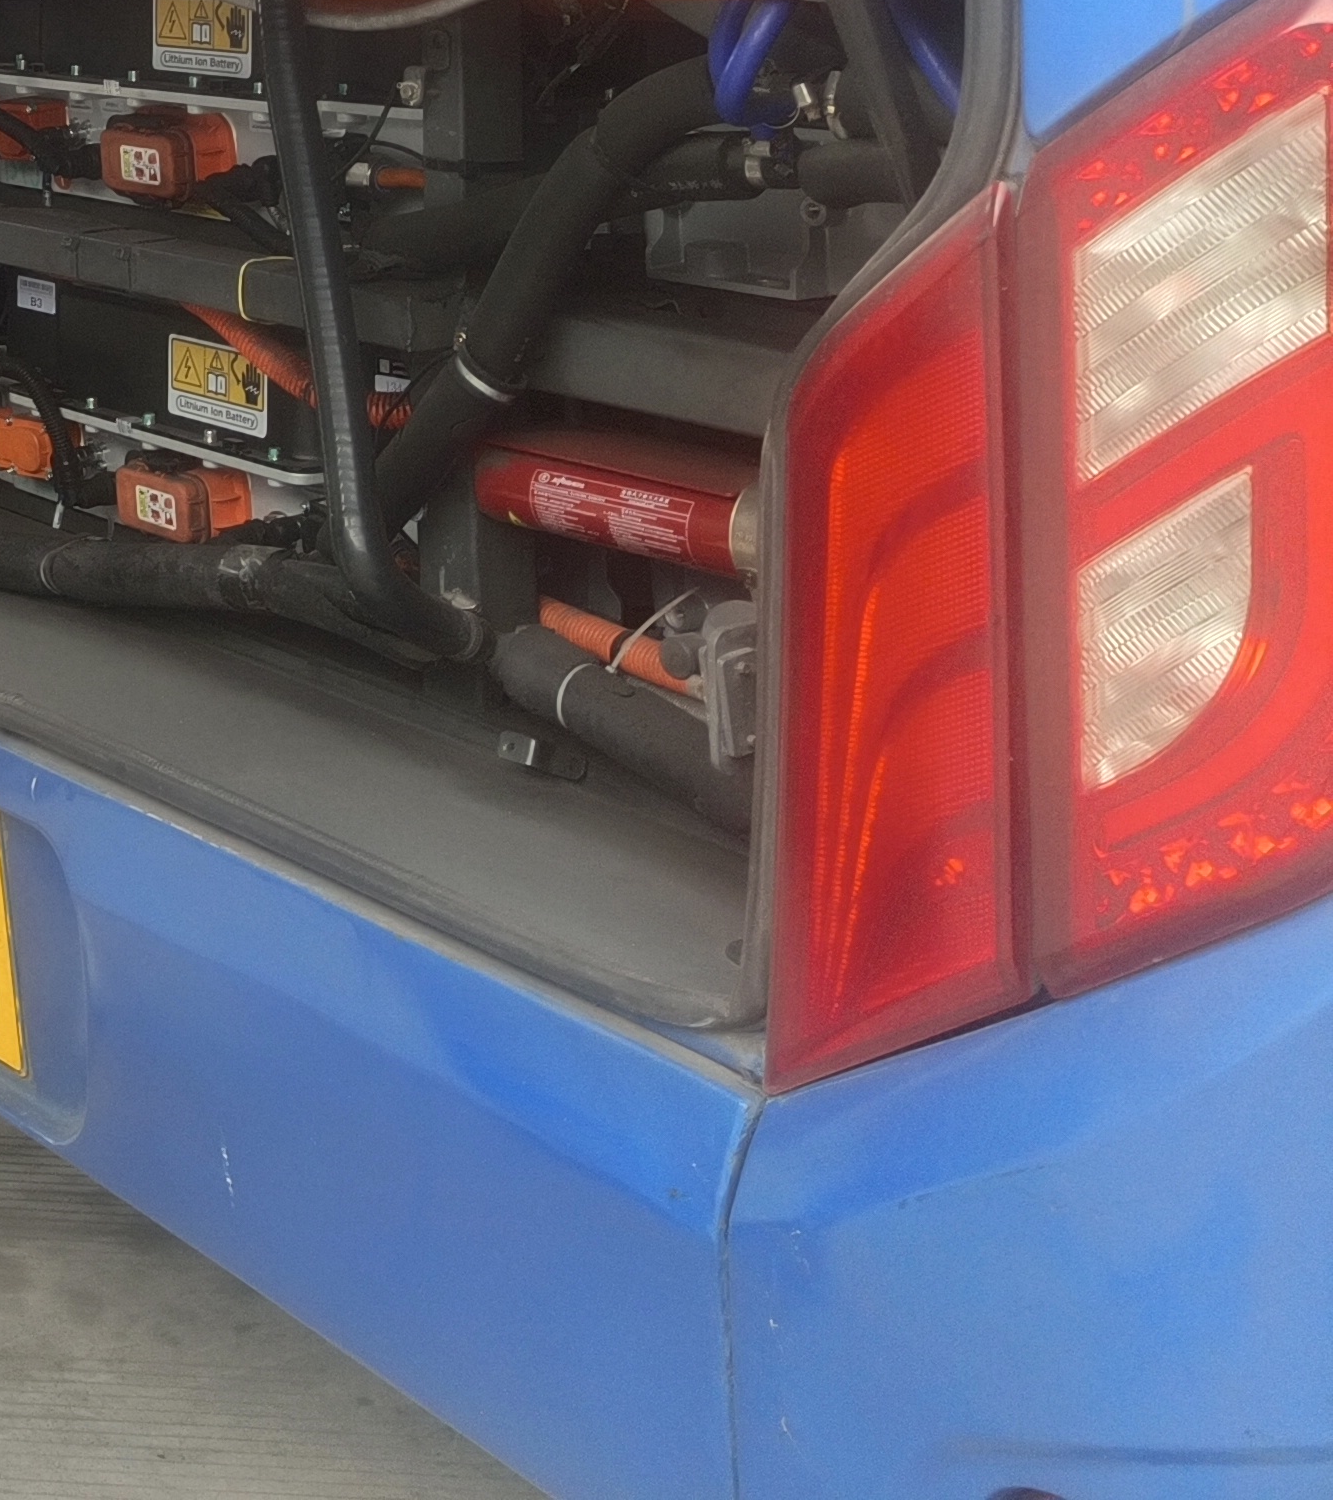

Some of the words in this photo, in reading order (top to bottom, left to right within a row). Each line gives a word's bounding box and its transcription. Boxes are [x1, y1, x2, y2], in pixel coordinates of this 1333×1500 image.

[163, 53, 194, 66] Lithium
[195, 56, 208, 67] Ion
[209, 57, 240, 72] Battery
[30, 296, 43, 309] B3
[179, 397, 209, 414] Lithium
[210, 406, 224, 418] Ion
[225, 410, 256, 428] Battery
